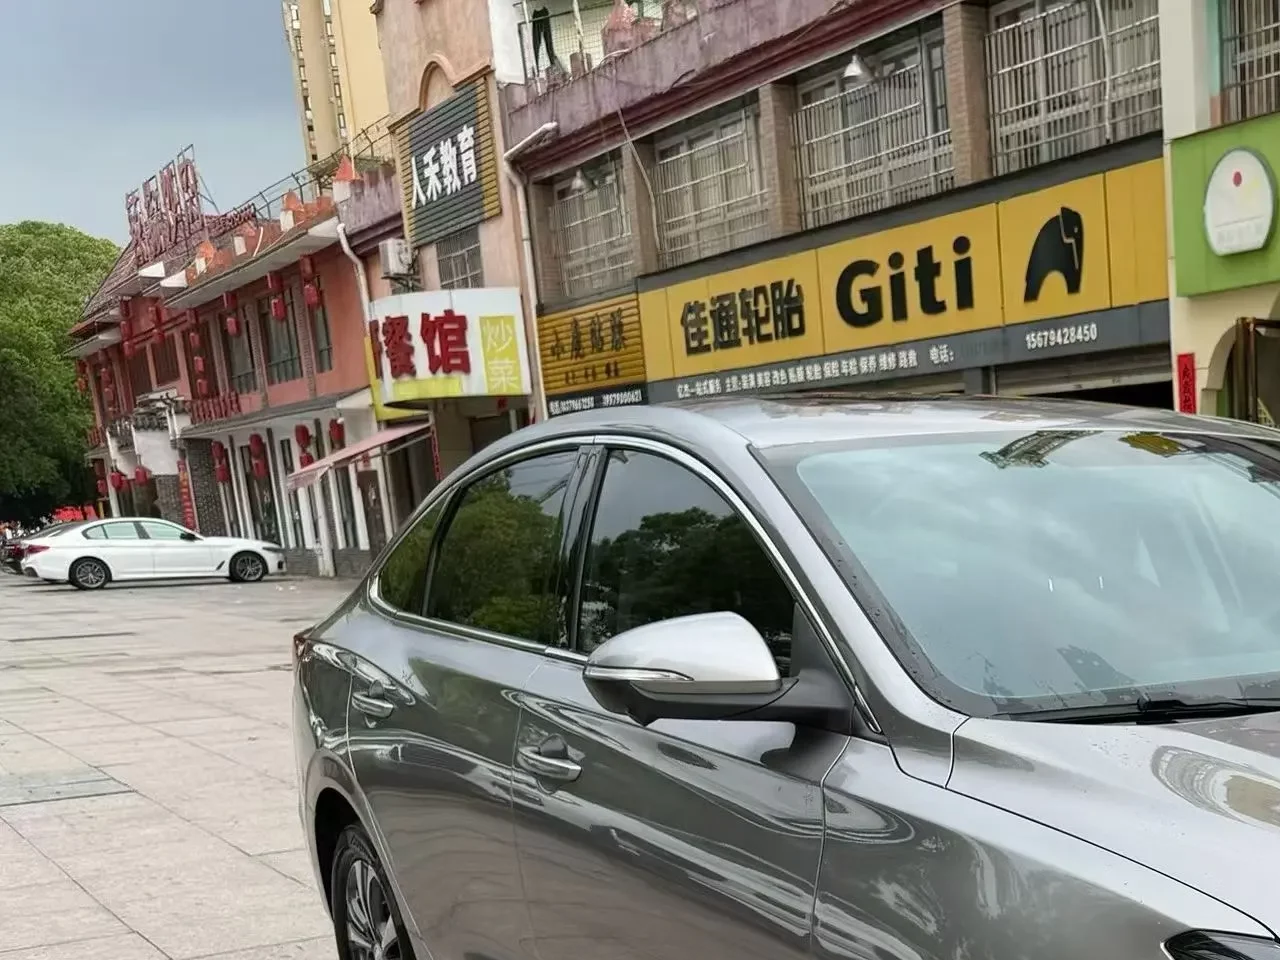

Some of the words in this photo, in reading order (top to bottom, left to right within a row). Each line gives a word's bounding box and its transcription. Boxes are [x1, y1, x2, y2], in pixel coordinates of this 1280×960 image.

[681, 279, 806, 357] 佳通轮胎
[836, 235, 974, 328] Giti
[369, 309, 471, 380] 餐馆
[482, 319, 519, 392] 炒菜
[930, 344, 954, 364] 电话:
